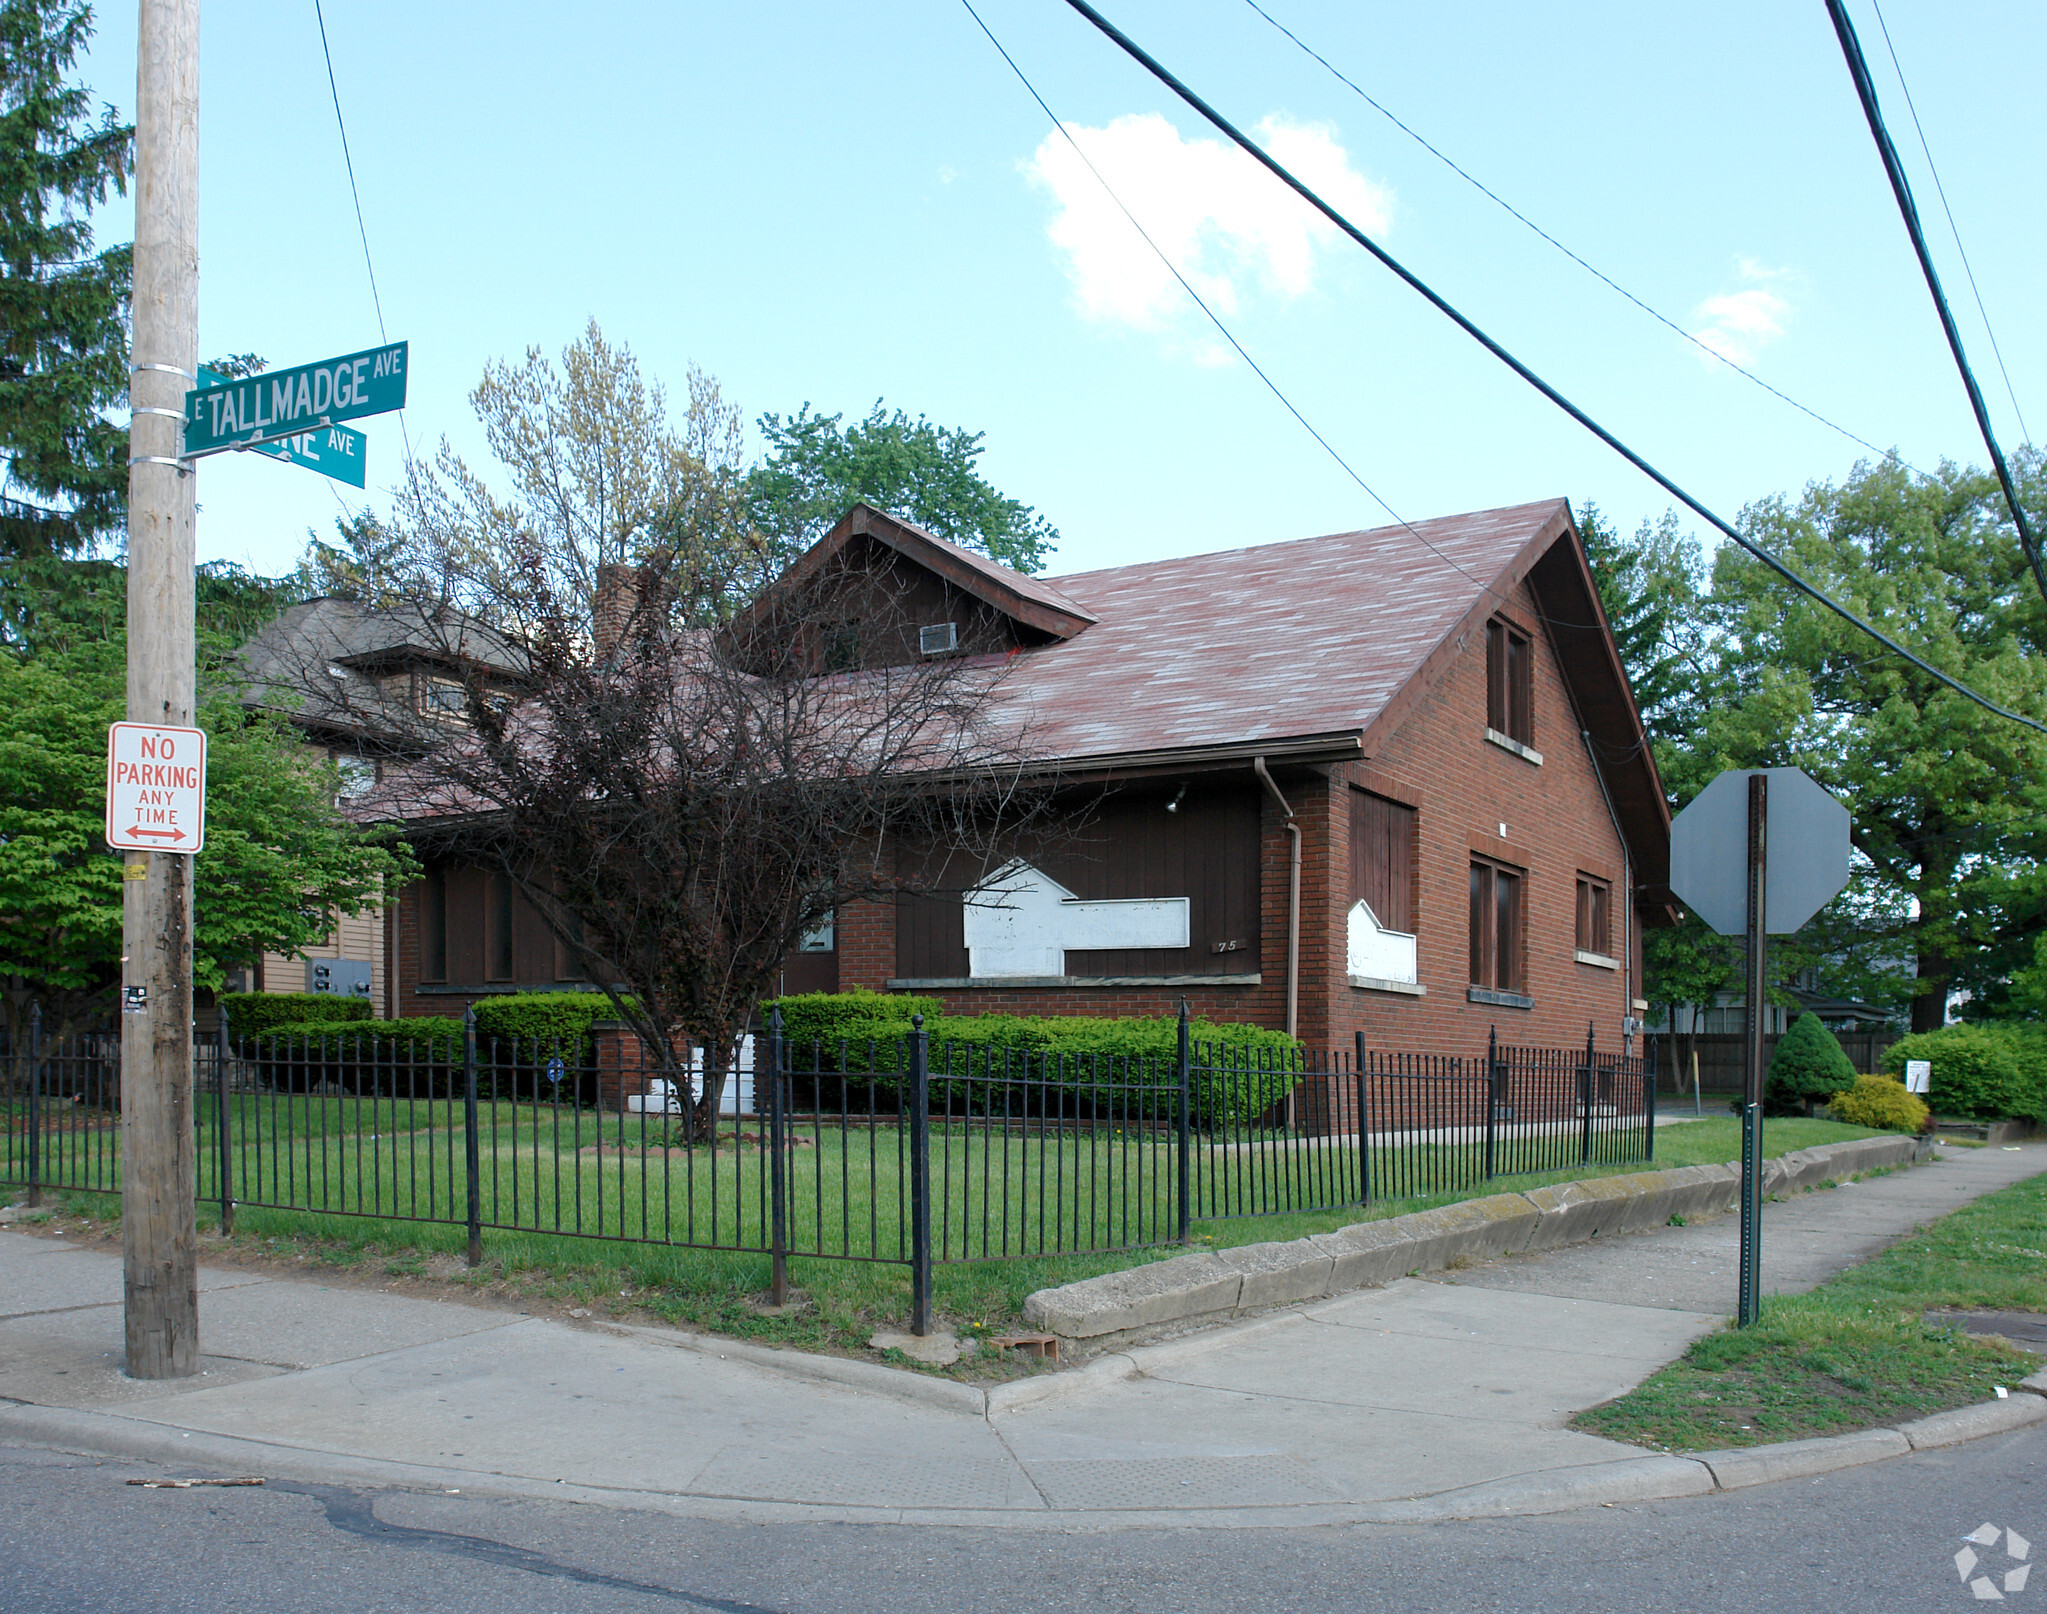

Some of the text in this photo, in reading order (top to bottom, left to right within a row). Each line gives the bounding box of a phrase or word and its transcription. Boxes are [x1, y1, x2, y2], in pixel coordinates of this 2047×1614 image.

[195, 349, 402, 437] E TALLMADGE AVE
[328, 428, 355, 457] AVE
[141, 736, 175, 760] NO
[116, 761, 198, 789] PARKING
[138, 789, 175, 807] ANY
[134, 807, 179, 825] TIME
[1218, 940, 1237, 952] 75
